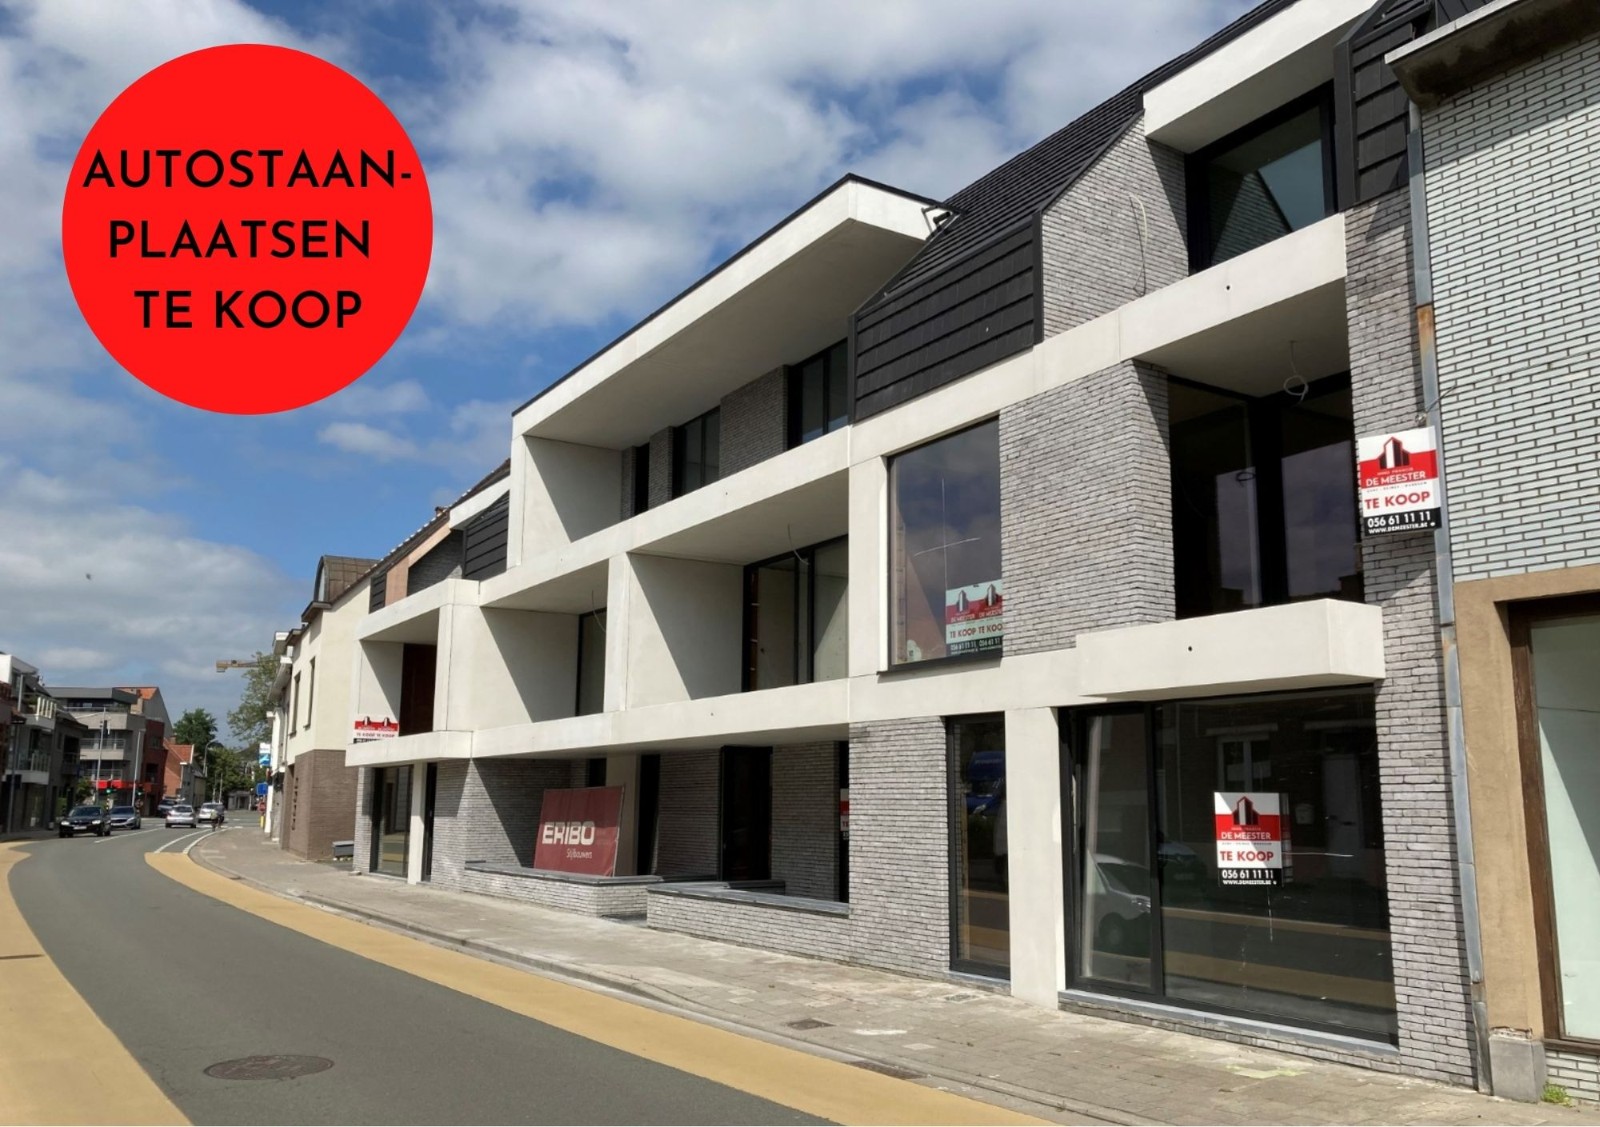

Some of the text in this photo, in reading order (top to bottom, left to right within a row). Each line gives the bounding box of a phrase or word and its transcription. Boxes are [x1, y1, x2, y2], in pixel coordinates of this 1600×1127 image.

[1366, 477, 1379, 487] DE
[1381, 470, 1426, 485] MEESTER
[1364, 491, 1430, 510] TE KOOP
[1367, 511, 1431, 528] 056 61 11 11
[958, 628, 976, 637] KOOP
[979, 623, 1003, 634] TE KOO
[542, 821, 595, 846] ERIBO
[1221, 831, 1271, 840] DE MEESTER
[1220, 850, 1274, 861] TE KOOP
[1222, 869, 1274, 879] 056 61 11 11
